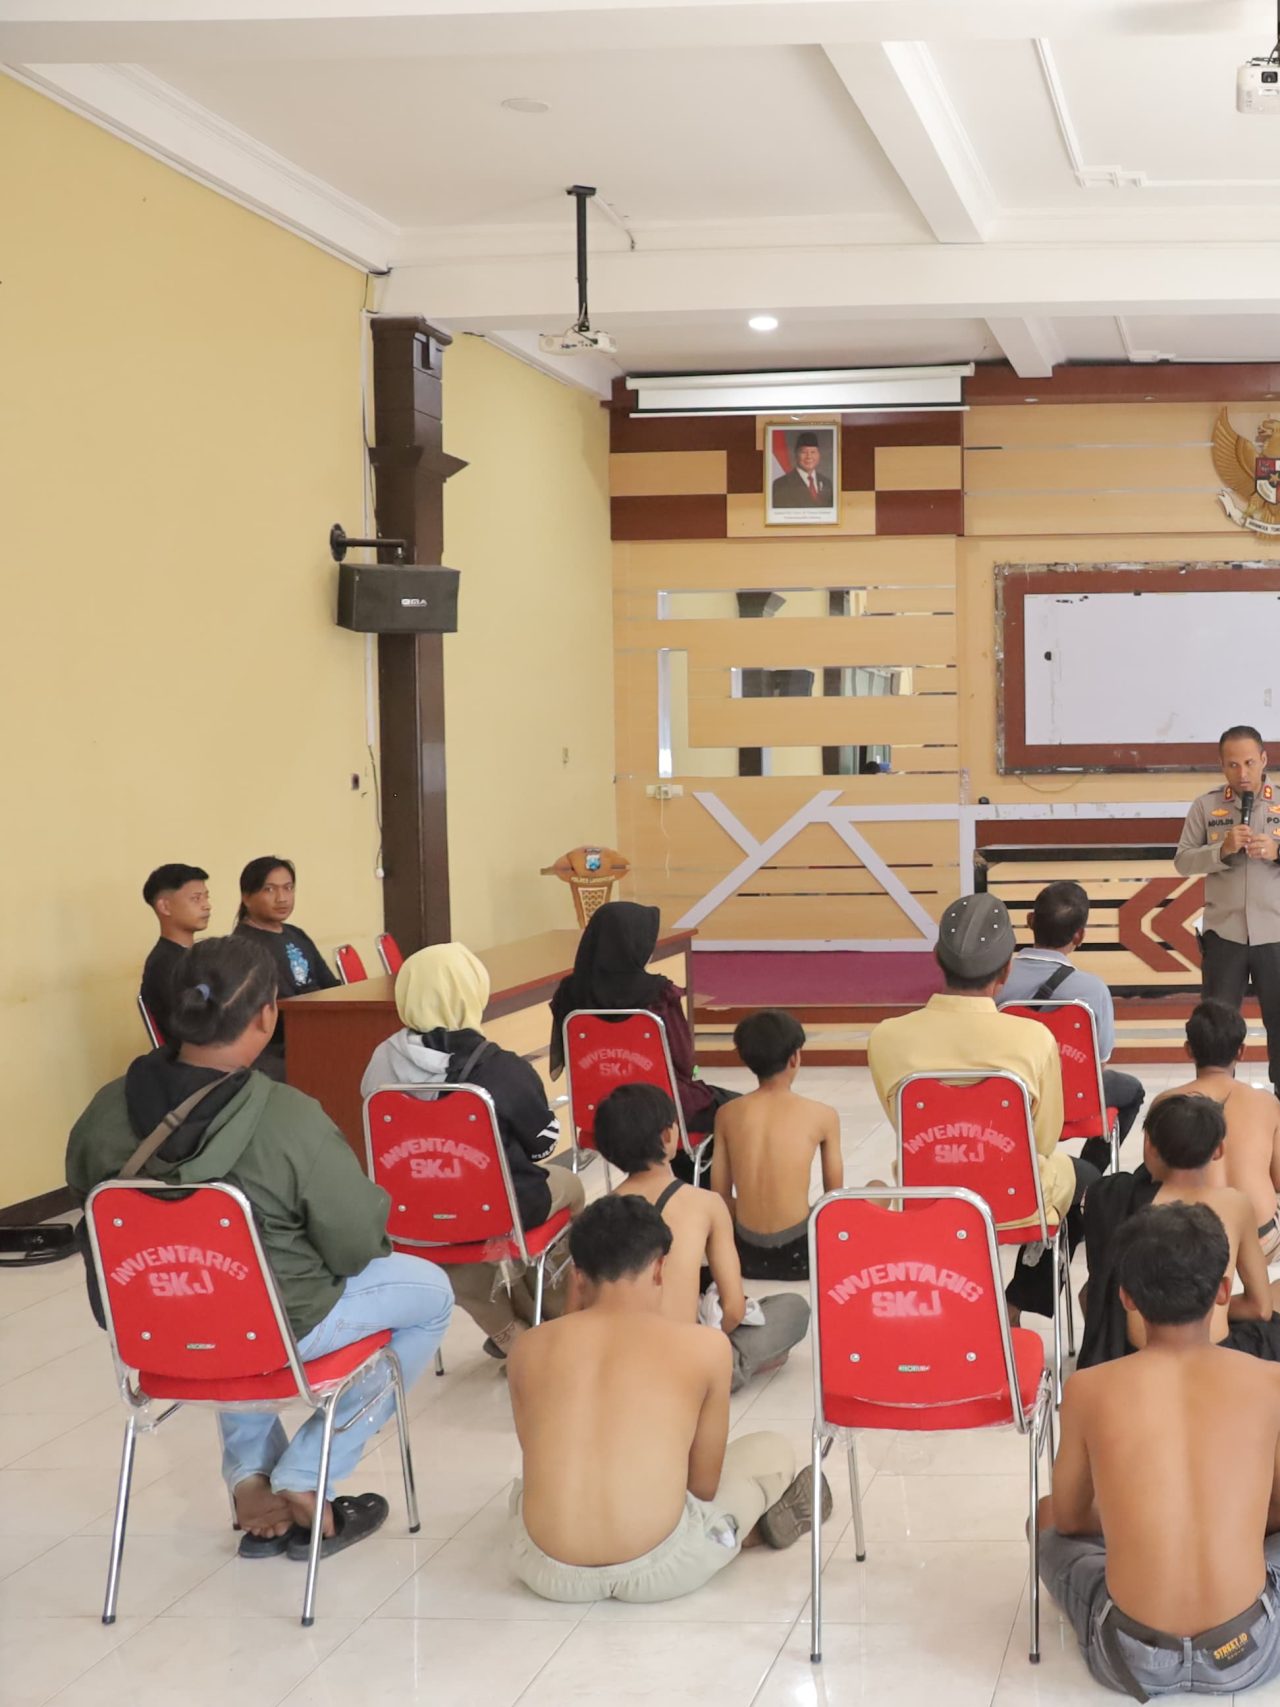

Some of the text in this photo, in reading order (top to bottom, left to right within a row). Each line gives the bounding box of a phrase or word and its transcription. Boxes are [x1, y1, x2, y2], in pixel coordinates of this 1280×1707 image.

[578, 1048, 654, 1072] INVENTARIS
[599, 1062, 633, 1077] SKJ
[903, 1121, 1016, 1155] INVENTARIS
[379, 1137, 491, 1170] INVENTARIS
[934, 1142, 985, 1163] SKJ
[409, 1158, 462, 1179] SKJ
[110, 1244, 249, 1286] INVENTARIS
[149, 1269, 215, 1297] SKJ
[827, 1261, 984, 1305] INVENTARIS
[871, 1289, 943, 1318] SKJ
